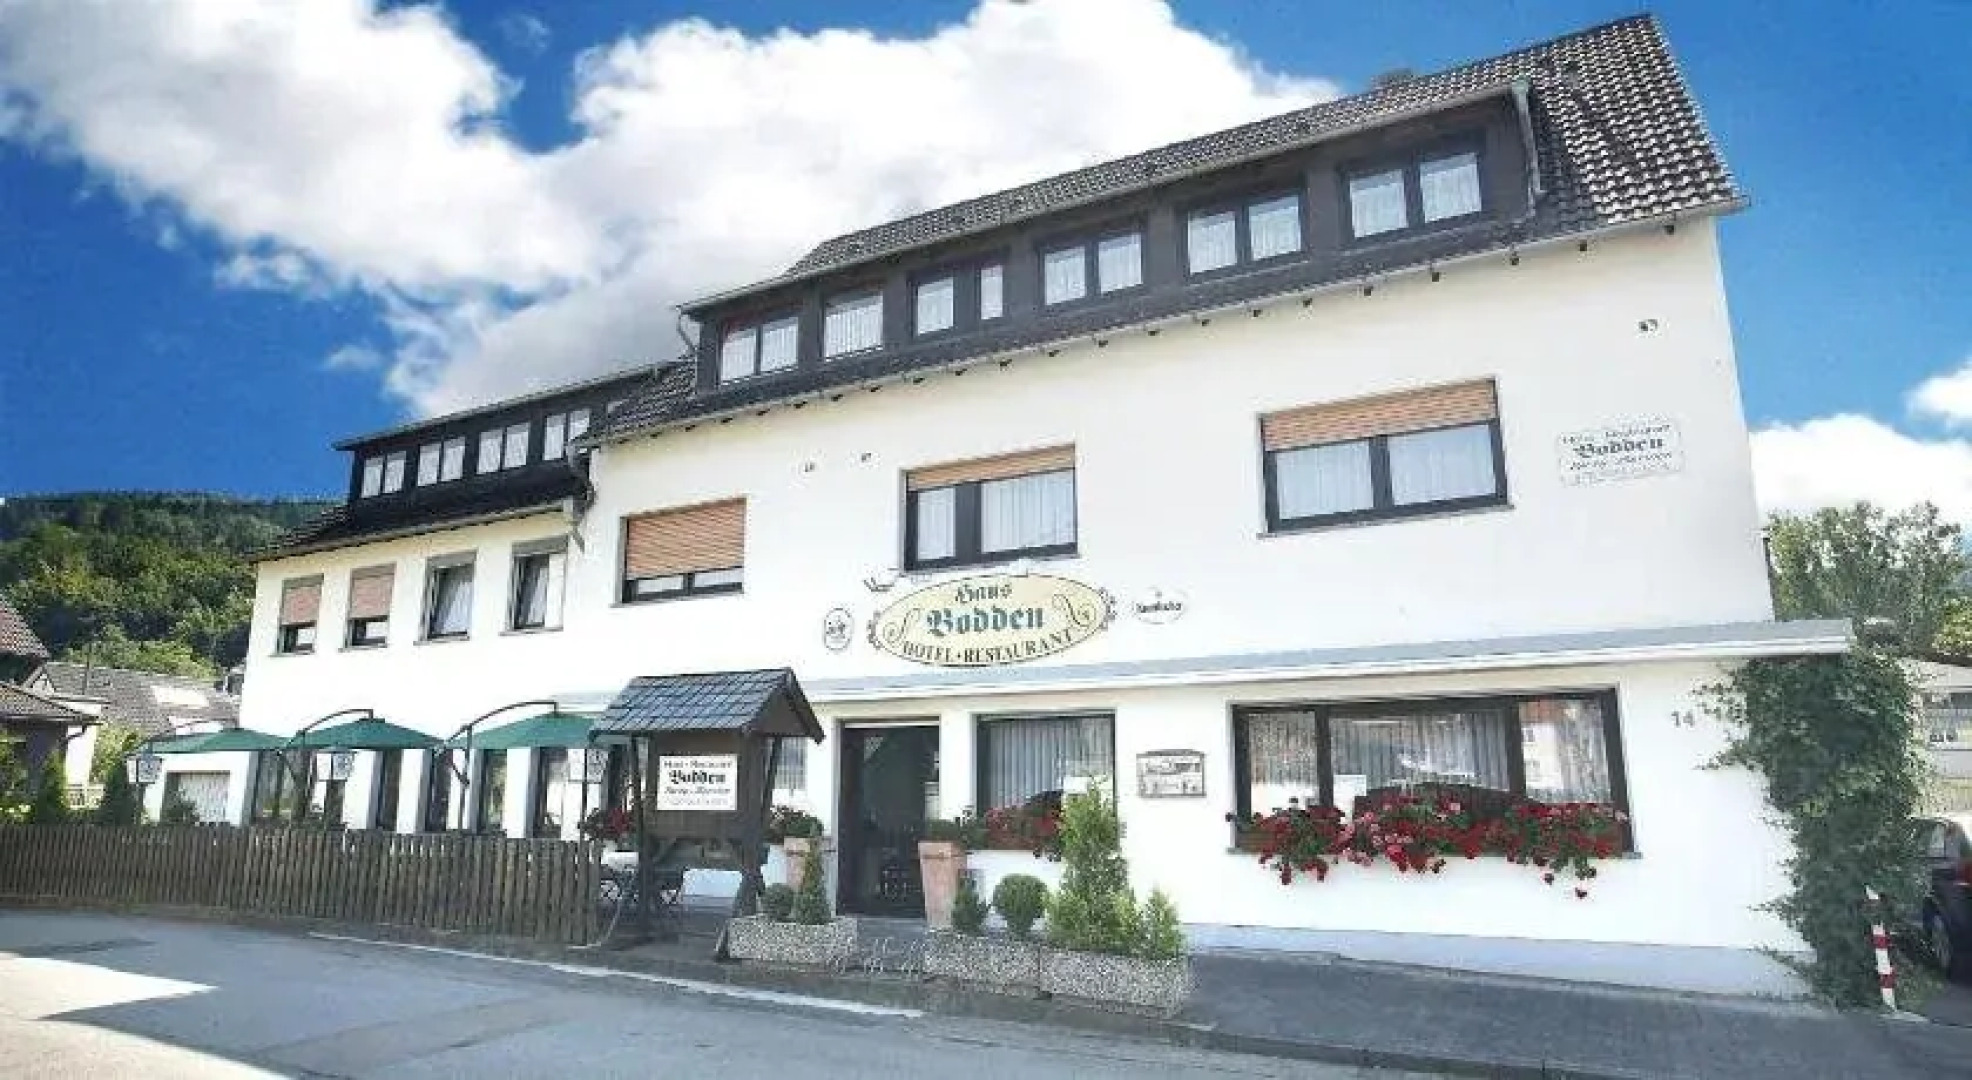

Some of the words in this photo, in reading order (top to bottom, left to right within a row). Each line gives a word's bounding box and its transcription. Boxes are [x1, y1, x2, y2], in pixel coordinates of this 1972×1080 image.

[955, 583, 1013, 604] Haus
[926, 605, 1043, 637] Bodden
[903, 640, 954, 662] HOTEL
[964, 628, 1076, 662] RESTAURANT
[1671, 710, 1695, 727] 14
